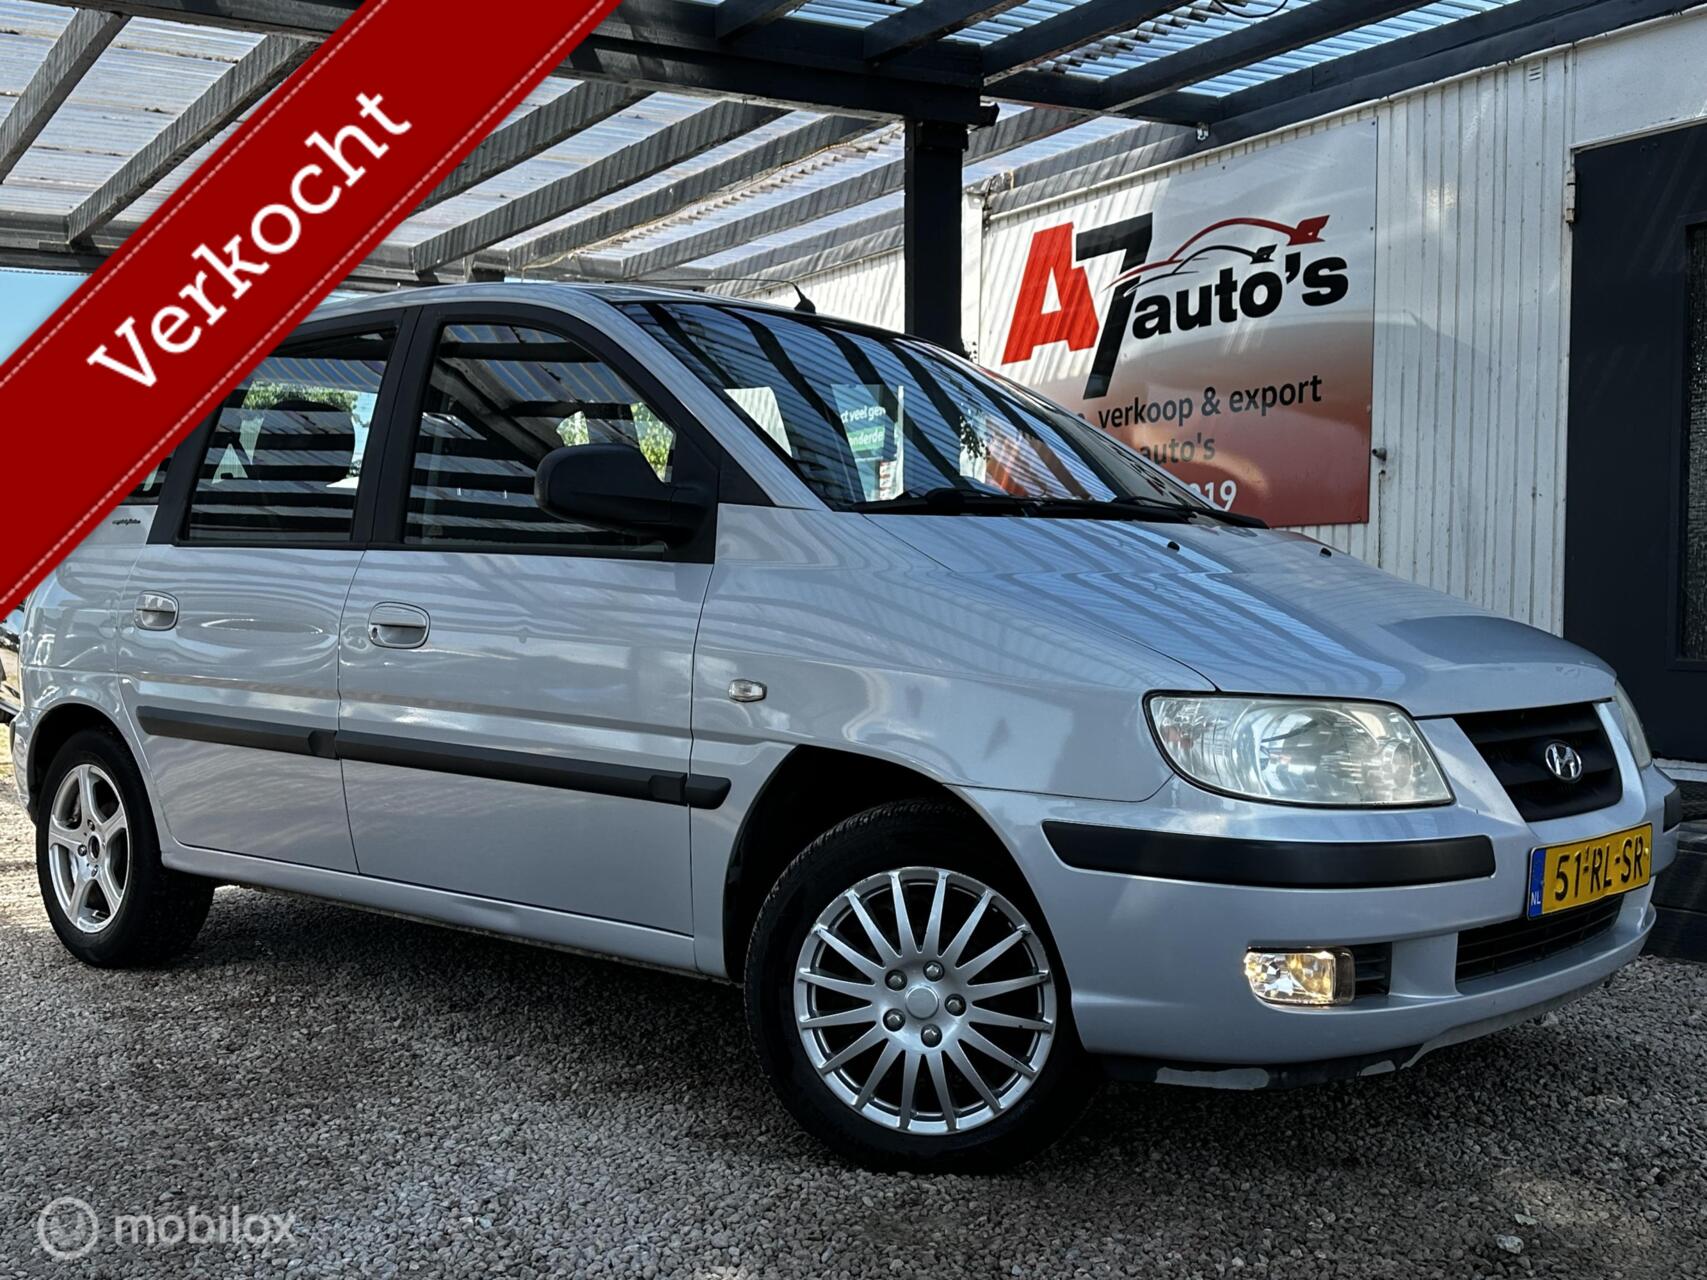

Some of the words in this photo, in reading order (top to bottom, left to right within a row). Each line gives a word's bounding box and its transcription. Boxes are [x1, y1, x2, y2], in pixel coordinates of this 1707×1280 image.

[1131, 251, 1349, 340] auto's
[1098, 397, 1194, 429] verkoop
[1201, 386, 1221, 417] &
[1229, 375, 1323, 417] export
[1530, 891, 1542, 906] NL
[1554, 836, 1644, 902] 51-RL-SR
